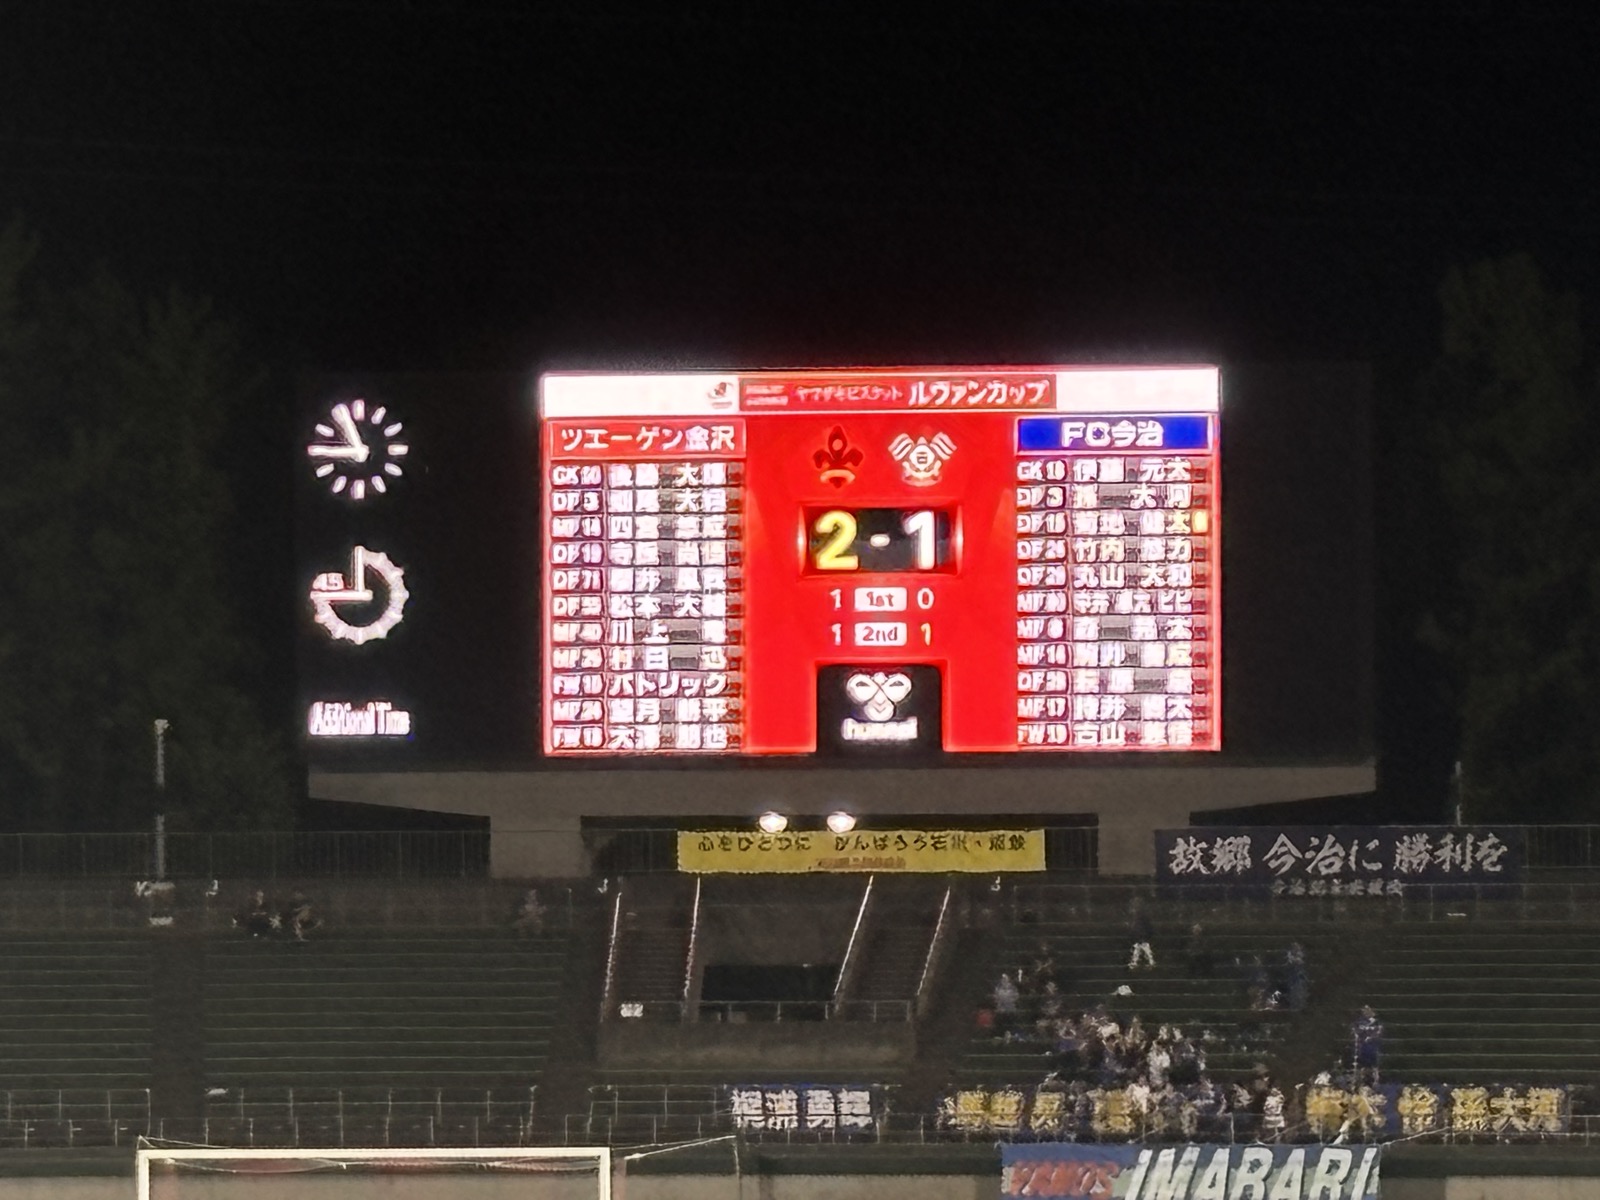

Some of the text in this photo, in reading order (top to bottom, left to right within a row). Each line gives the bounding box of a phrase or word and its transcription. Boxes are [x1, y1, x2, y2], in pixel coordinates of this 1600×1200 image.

[816, 510, 858, 570] 2
[904, 510, 935, 570] 1
[830, 588, 934, 611] 1 1st 0
[831, 622, 932, 646] 1 2nd 1
[609, 673, 727, 696] パトリック
[1125, 1146, 1378, 1200] IMABARI
